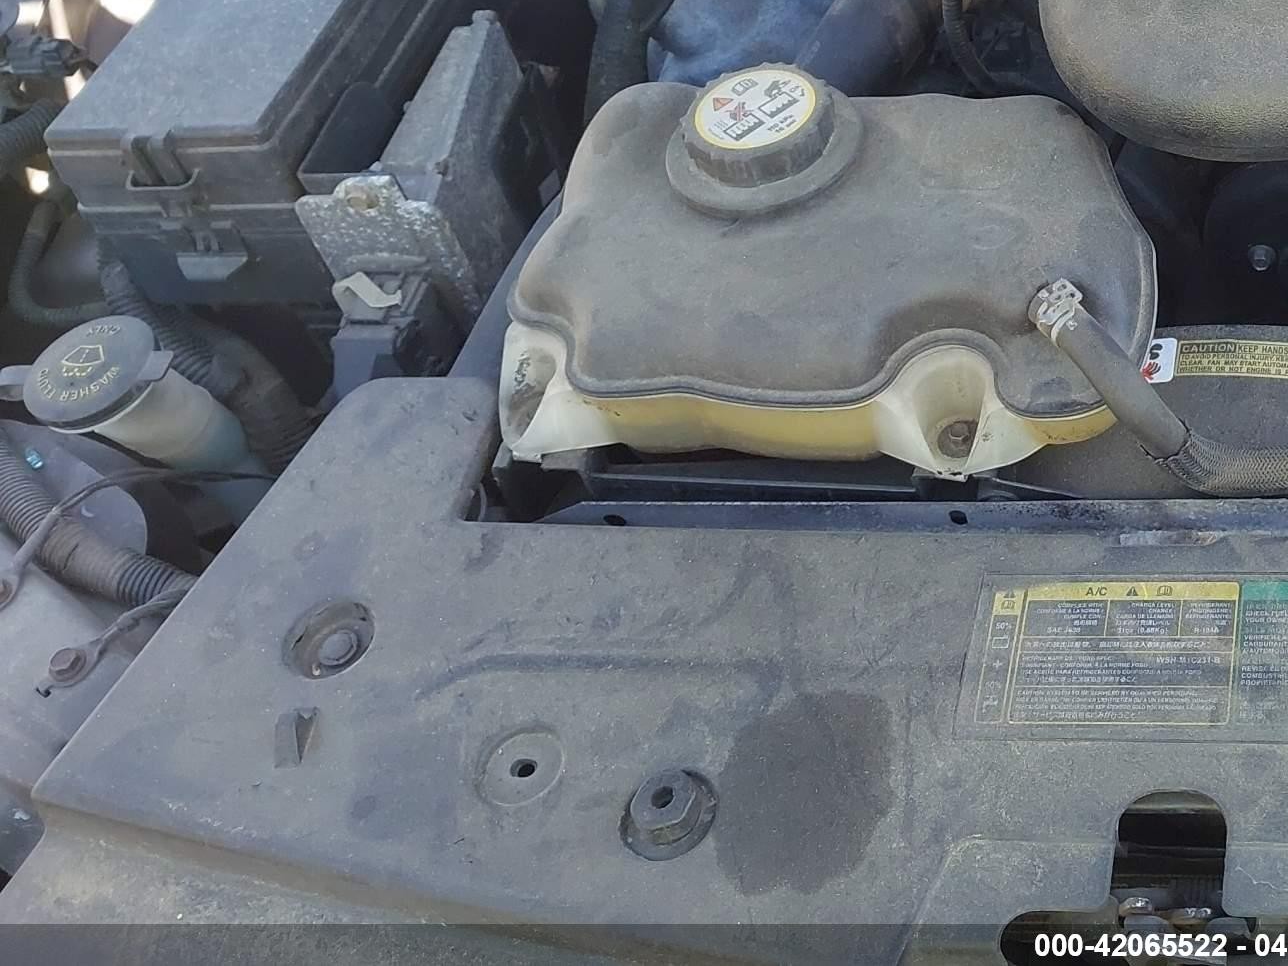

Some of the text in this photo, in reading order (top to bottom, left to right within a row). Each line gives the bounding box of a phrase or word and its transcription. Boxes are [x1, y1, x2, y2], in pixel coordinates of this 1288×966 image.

[1182, 343, 1236, 353] CAUTION
[1238, 344, 1259, 354] KEEP
[1261, 345, 1288, 355] HANDS
[39, 368, 57, 399] FLUID
[60, 366, 120, 401] WASHER
[1085, 585, 1108, 597] A/C
